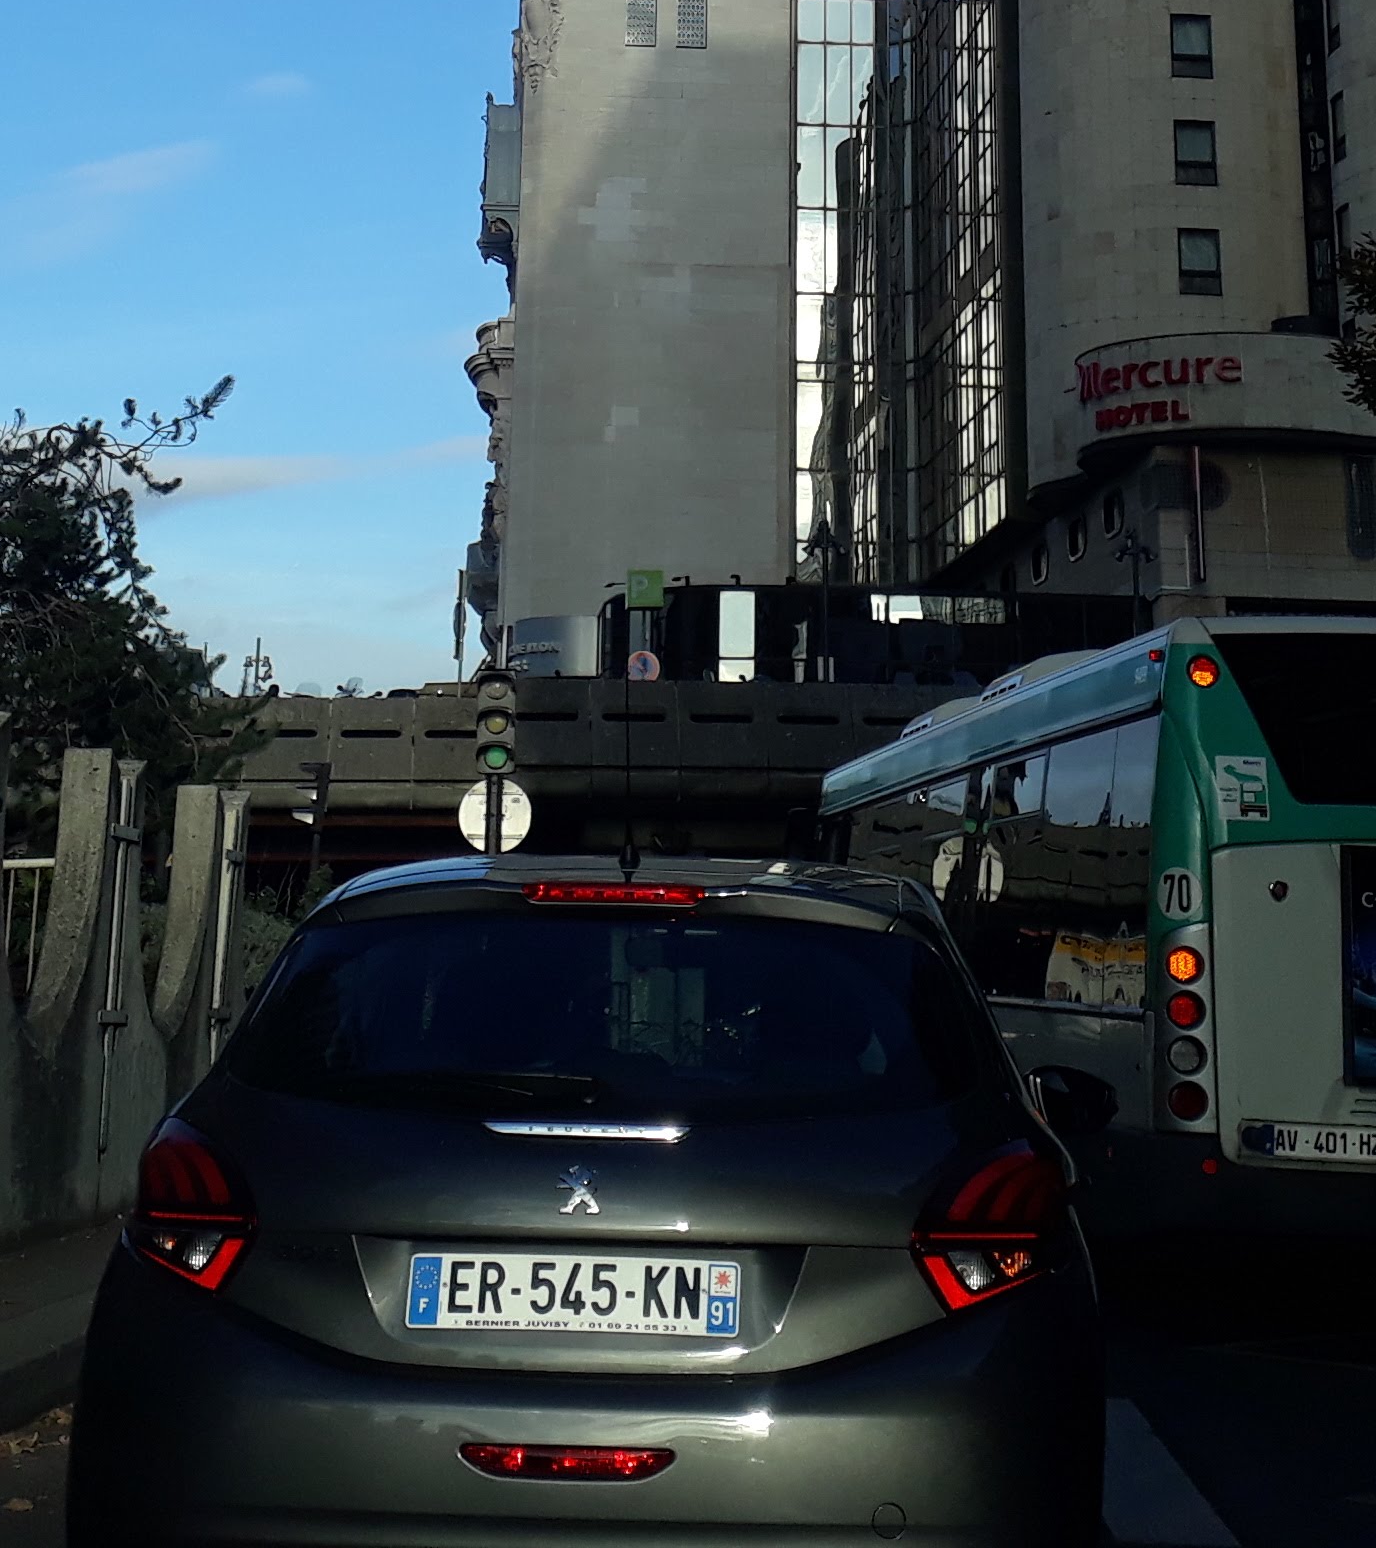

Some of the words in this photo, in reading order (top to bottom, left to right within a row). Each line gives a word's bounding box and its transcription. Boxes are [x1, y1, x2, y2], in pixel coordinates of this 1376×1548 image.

[1078, 357, 1242, 403] Mercure
[1095, 400, 1190, 432] HOTEL
[630, 573, 649, 599] P
[1163, 874, 1191, 913] 70
[447, 1260, 702, 1320] ER-545-KN
[417, 1297, 430, 1315] F
[710, 1300, 734, 1327] 91
[465, 1319, 521, 1328] BERNIER
[524, 1320, 570, 1328] JUVISY
